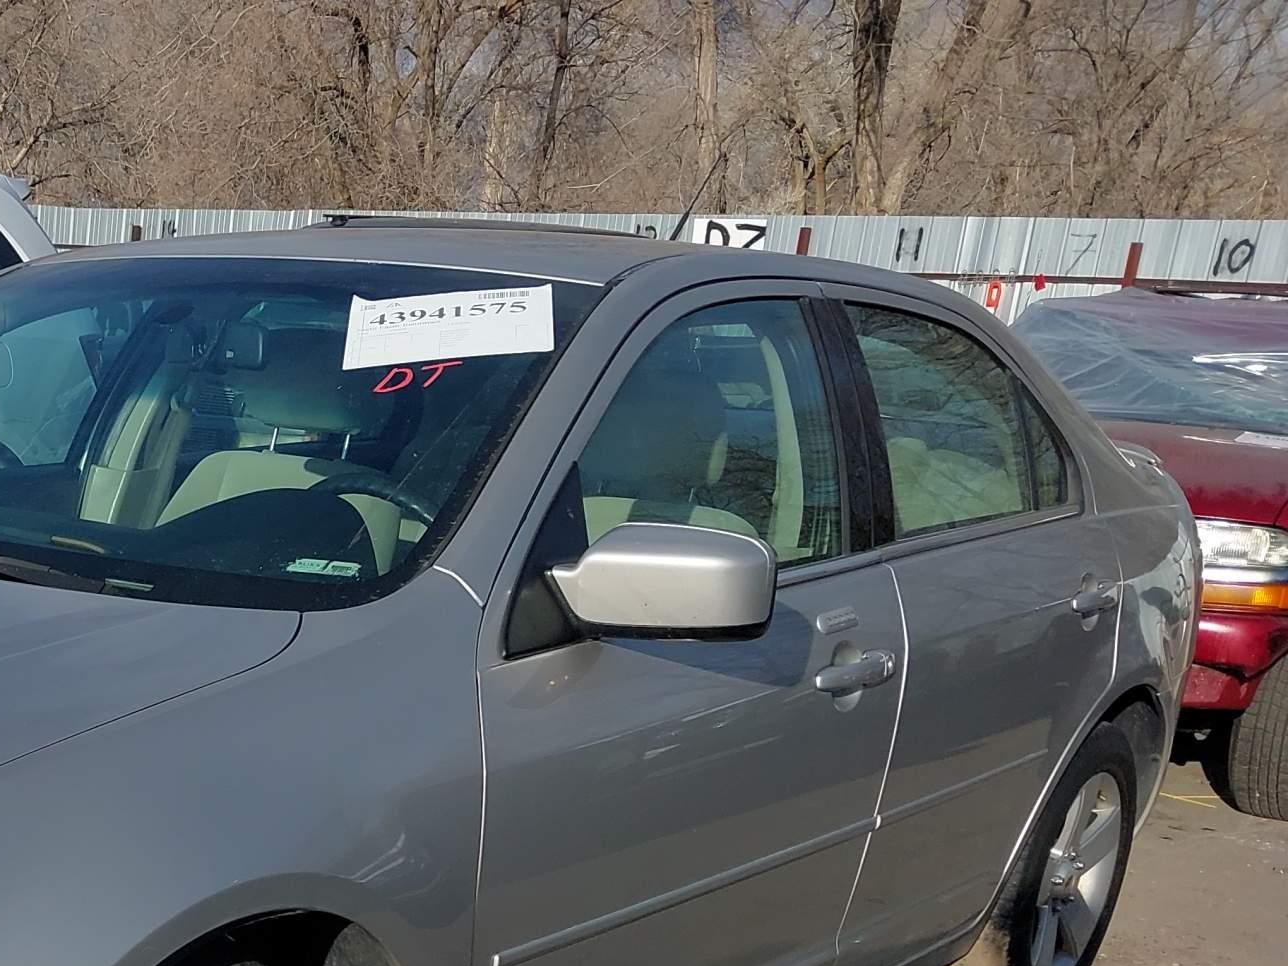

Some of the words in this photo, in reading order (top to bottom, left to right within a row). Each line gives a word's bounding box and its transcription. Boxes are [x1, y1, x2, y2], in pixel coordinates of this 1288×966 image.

[1065, 233, 1098, 276] 7
[1212, 237, 1256, 277] 10
[369, 301, 528, 326] 43941575
